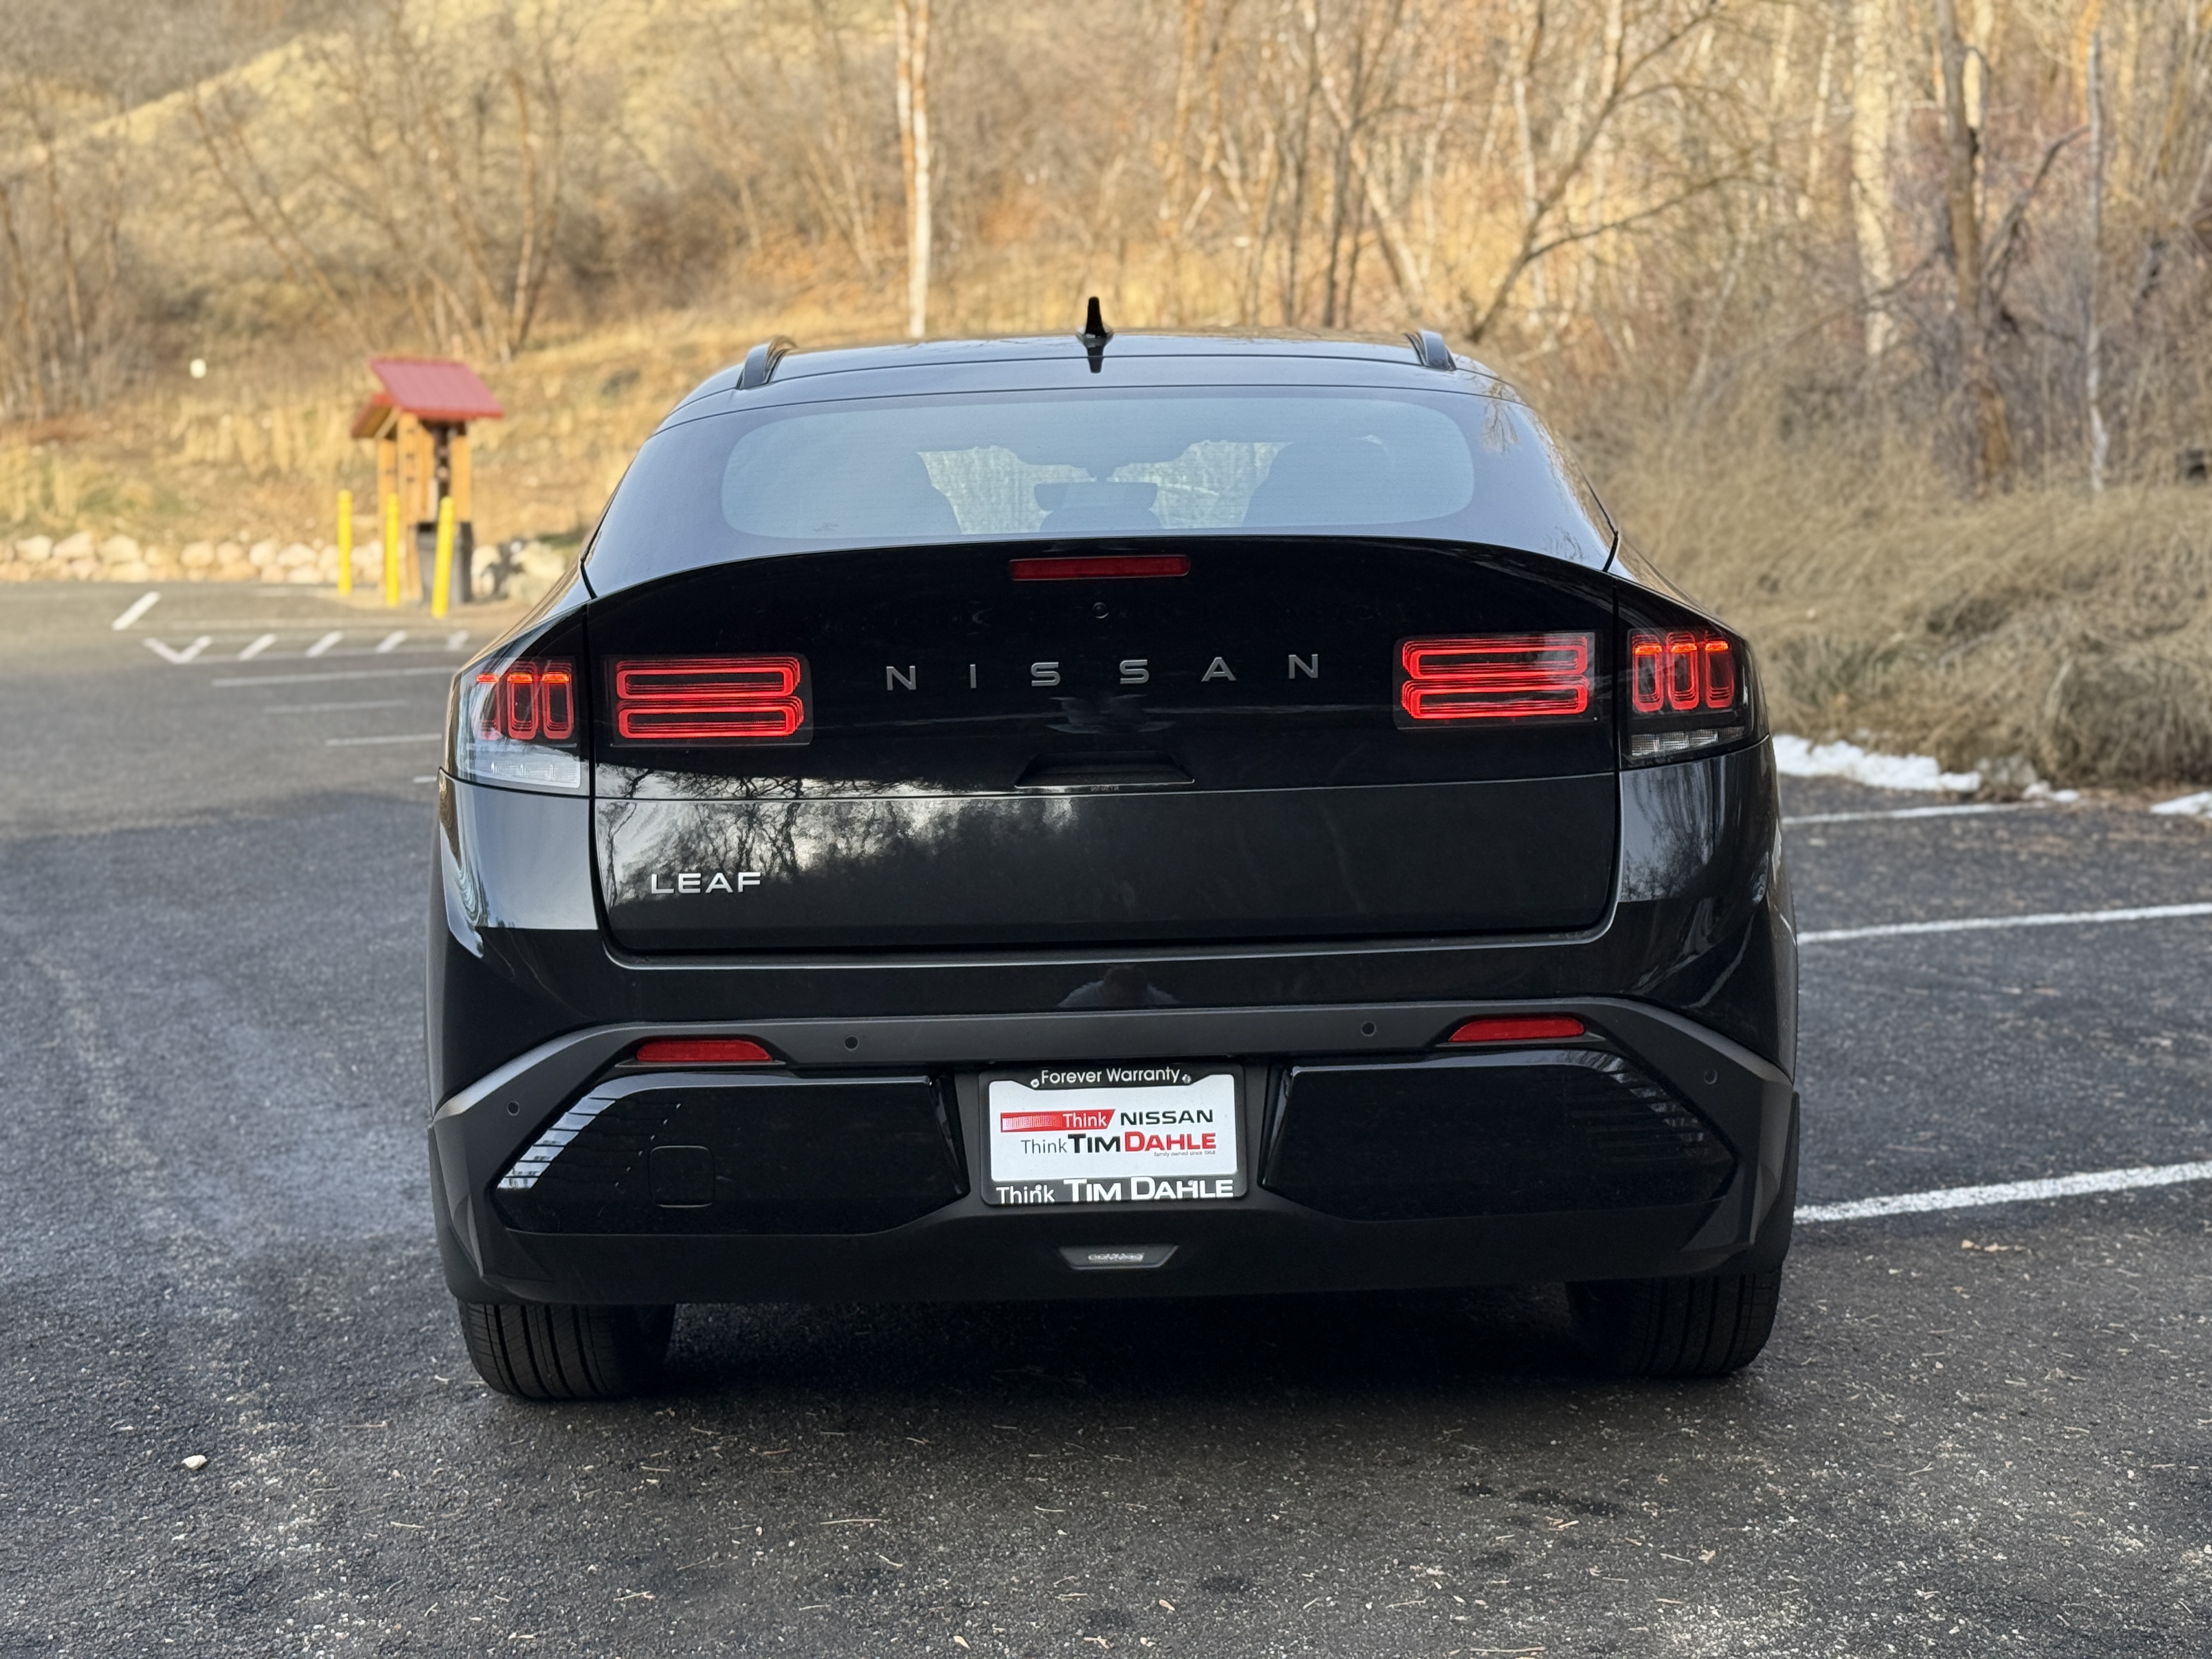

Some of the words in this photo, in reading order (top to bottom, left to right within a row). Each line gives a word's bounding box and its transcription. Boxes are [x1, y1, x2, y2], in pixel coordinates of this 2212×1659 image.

[885, 654, 1318, 691] NISSAN
[651, 872, 761, 894] LEAF
[1041, 1070, 1102, 1085] Forever
[1107, 1066, 1181, 1084] Warranty
[1063, 1113, 1107, 1128] Think
[1120, 1109, 1214, 1126] NISSAN
[1020, 1138, 1067, 1154] Think
[1068, 1133, 1120, 1154] TIM
[1125, 1131, 1216, 1152] DAHLE
[996, 1185, 1055, 1204] Think
[1063, 1178, 1121, 1203] TIM
[1131, 1177, 1234, 1201] DAHLE
